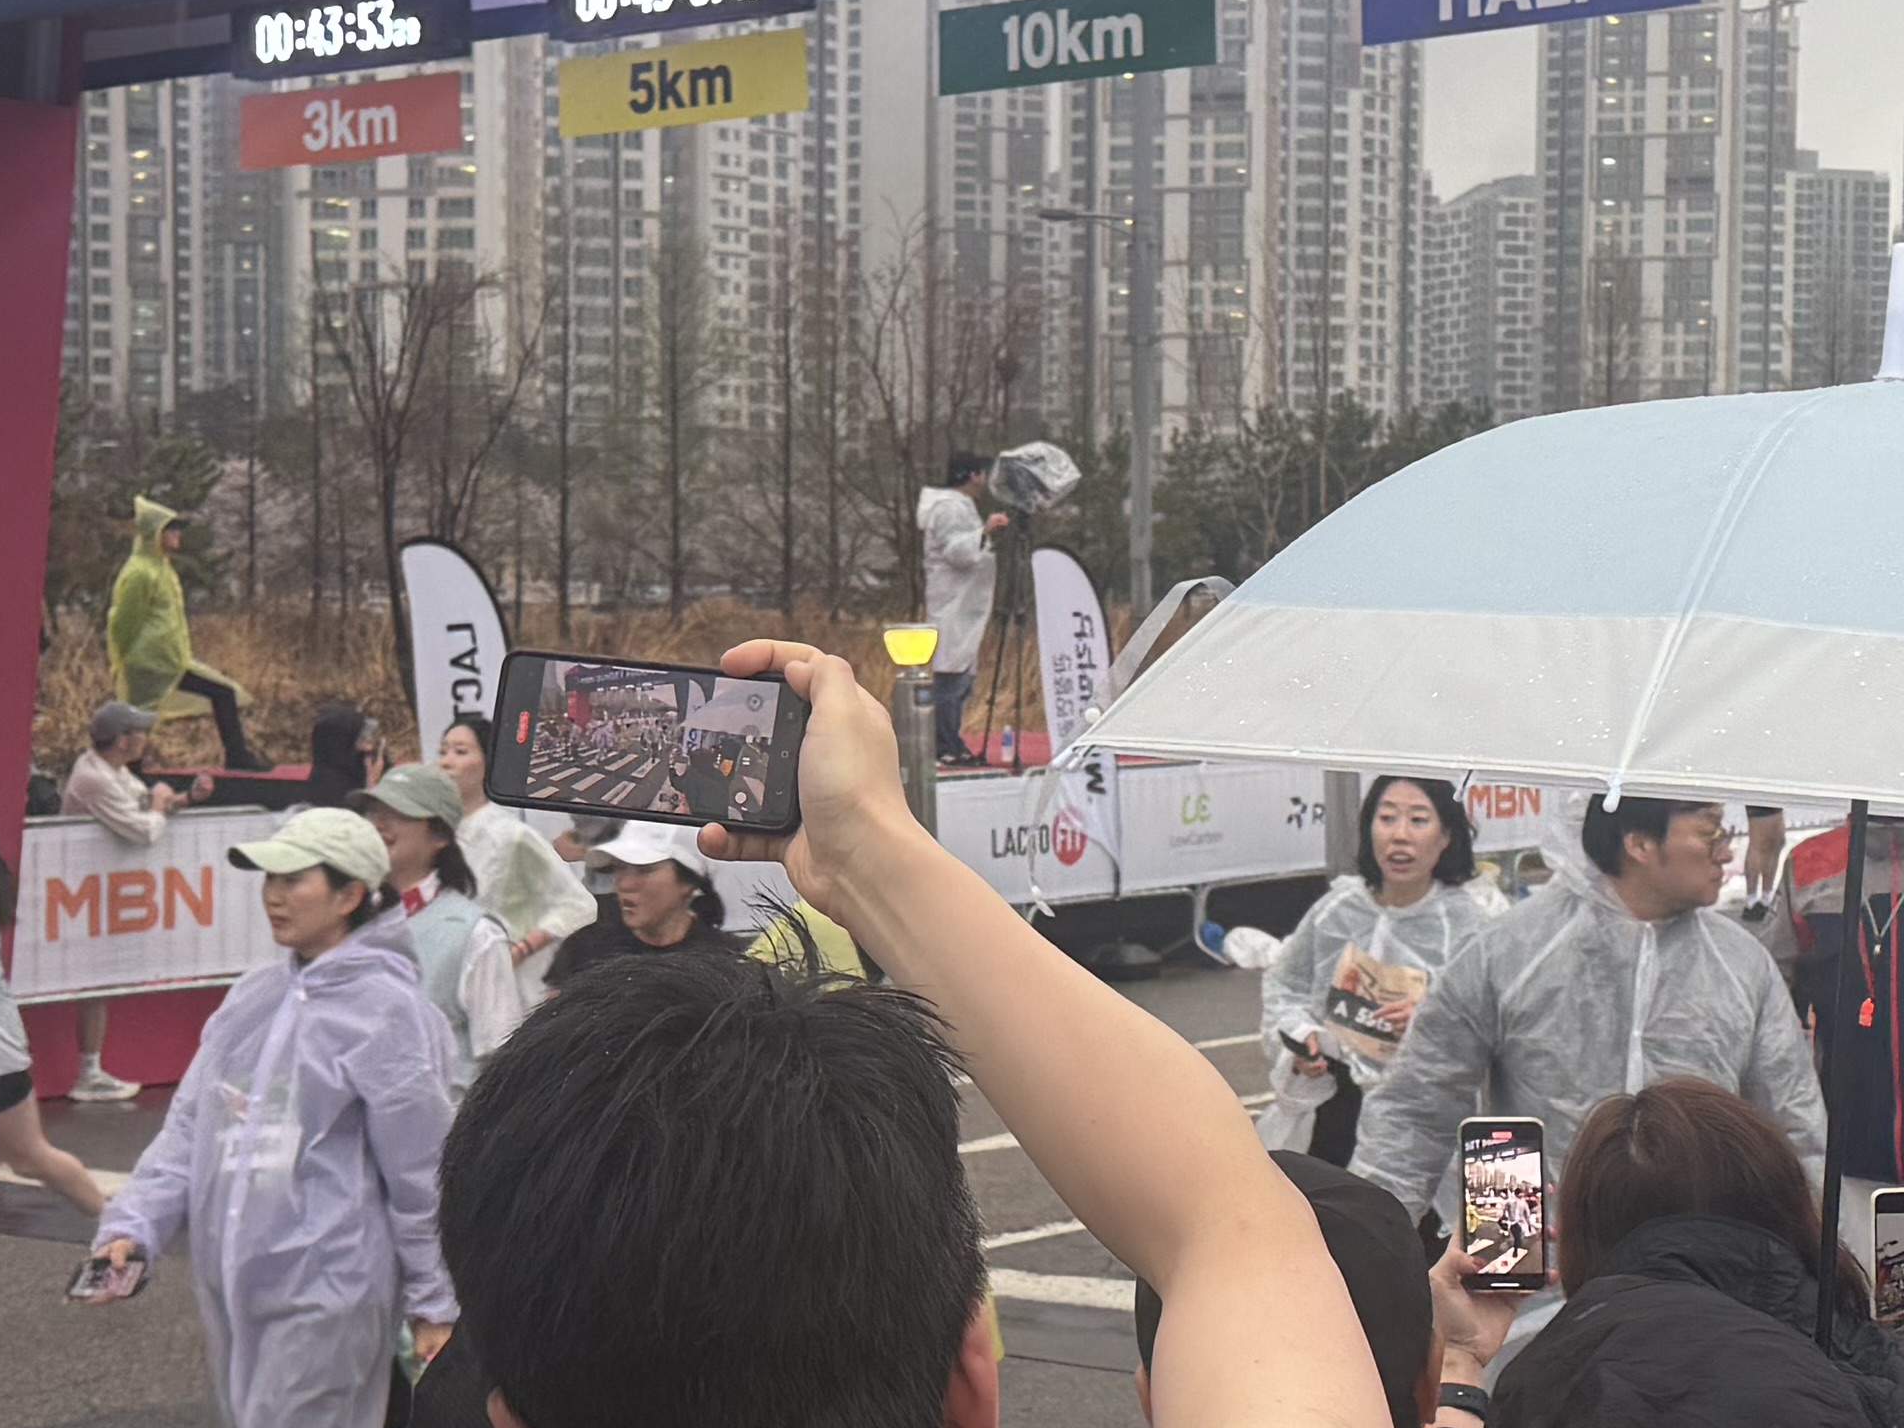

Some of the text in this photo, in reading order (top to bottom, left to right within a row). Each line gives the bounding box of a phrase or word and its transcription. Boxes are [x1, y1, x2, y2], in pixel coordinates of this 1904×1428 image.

[1002, 8, 1144, 72] 10km
[629, 60, 732, 114] 5km
[302, 99, 397, 152] 3km
[1467, 784, 1542, 821] MBN
[44, 865, 214, 943] MBN
